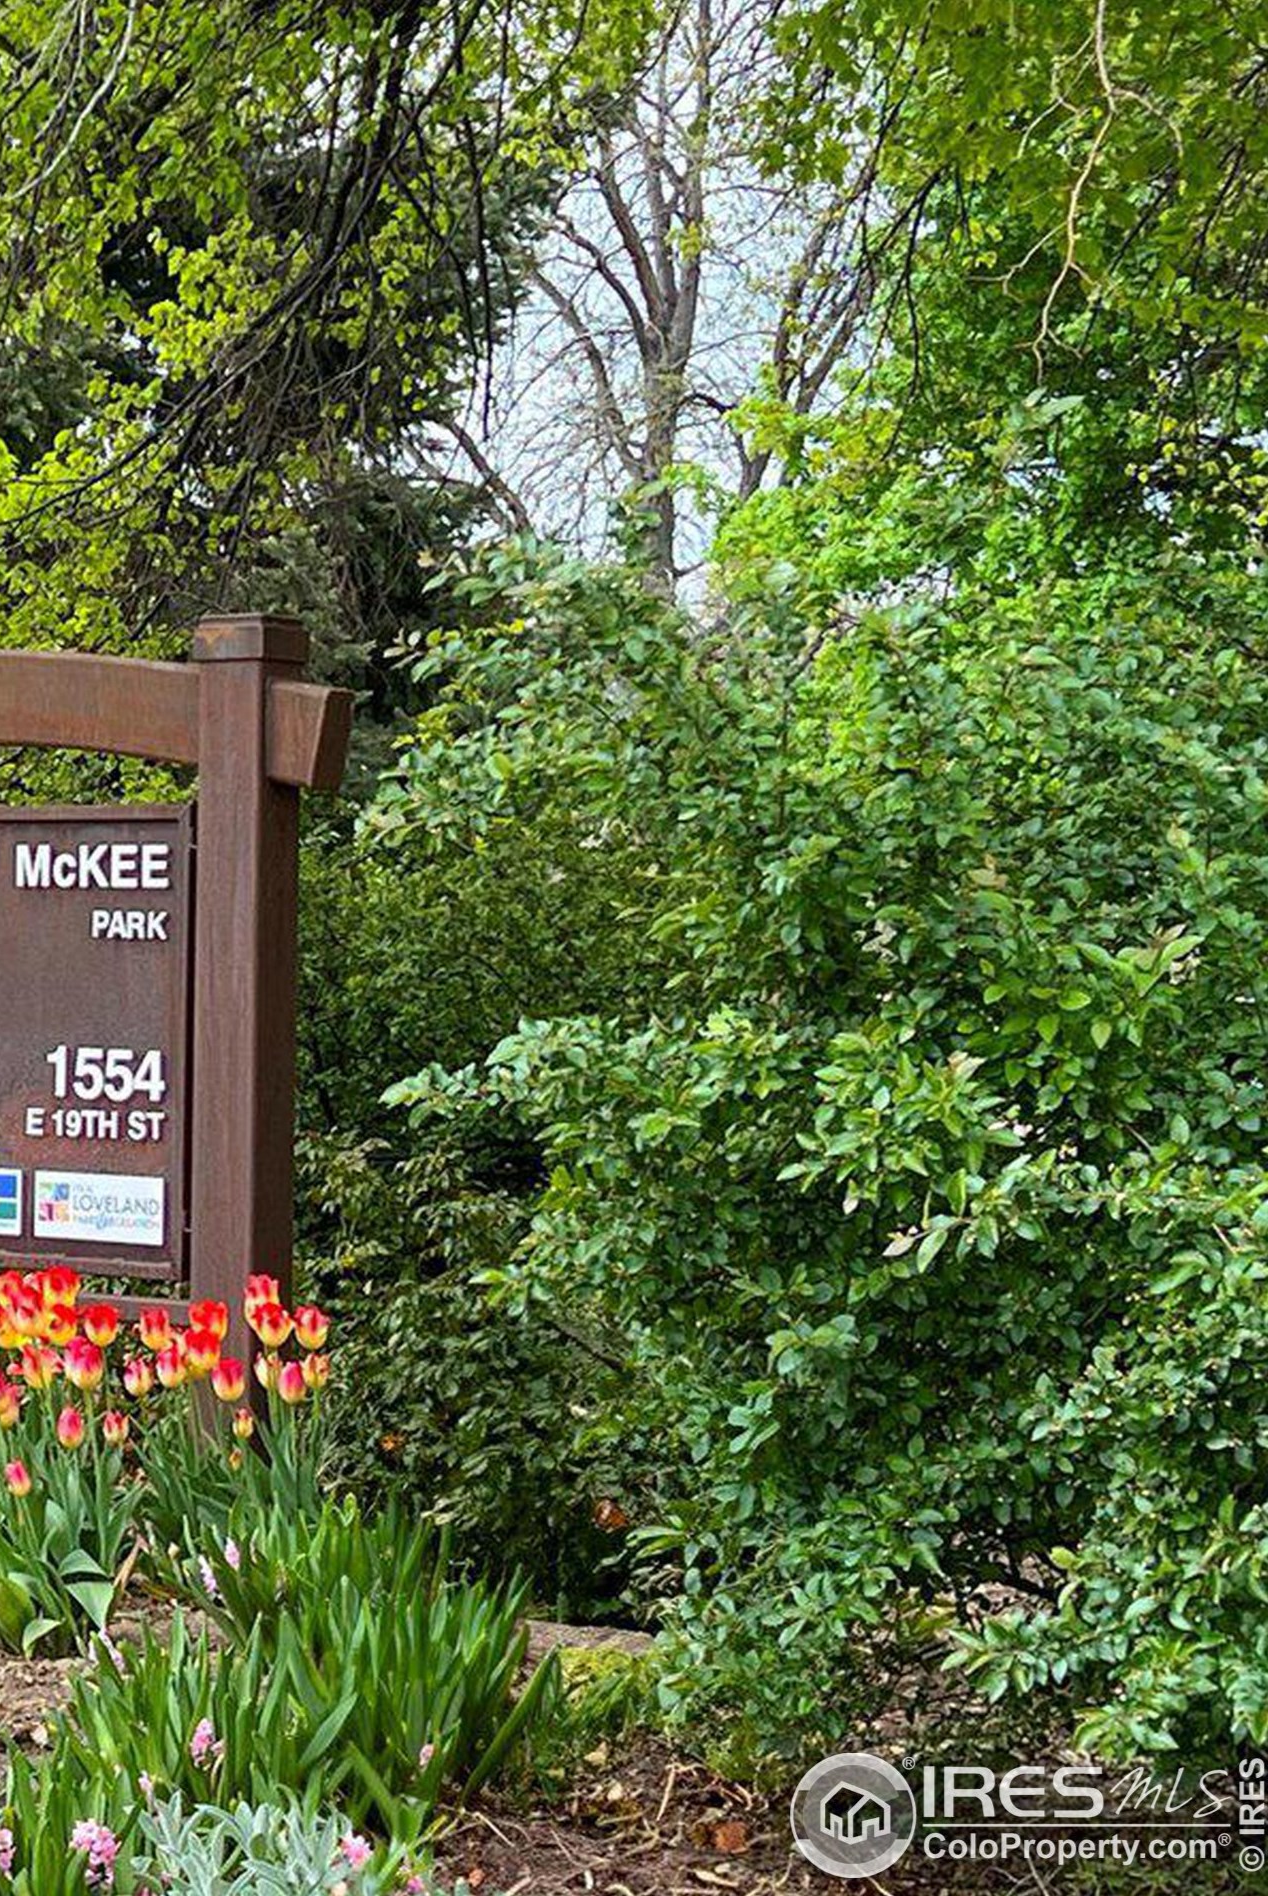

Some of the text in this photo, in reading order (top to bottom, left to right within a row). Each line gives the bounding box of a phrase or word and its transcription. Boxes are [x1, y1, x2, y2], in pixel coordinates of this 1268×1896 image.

[15, 843, 170, 889] McKEE
[90, 909, 168, 941] PARK
[46, 1044, 166, 1102] 1554
[25, 1107, 166, 1142] E 19TH ST
[72, 1193, 160, 1217] LOVELAND
